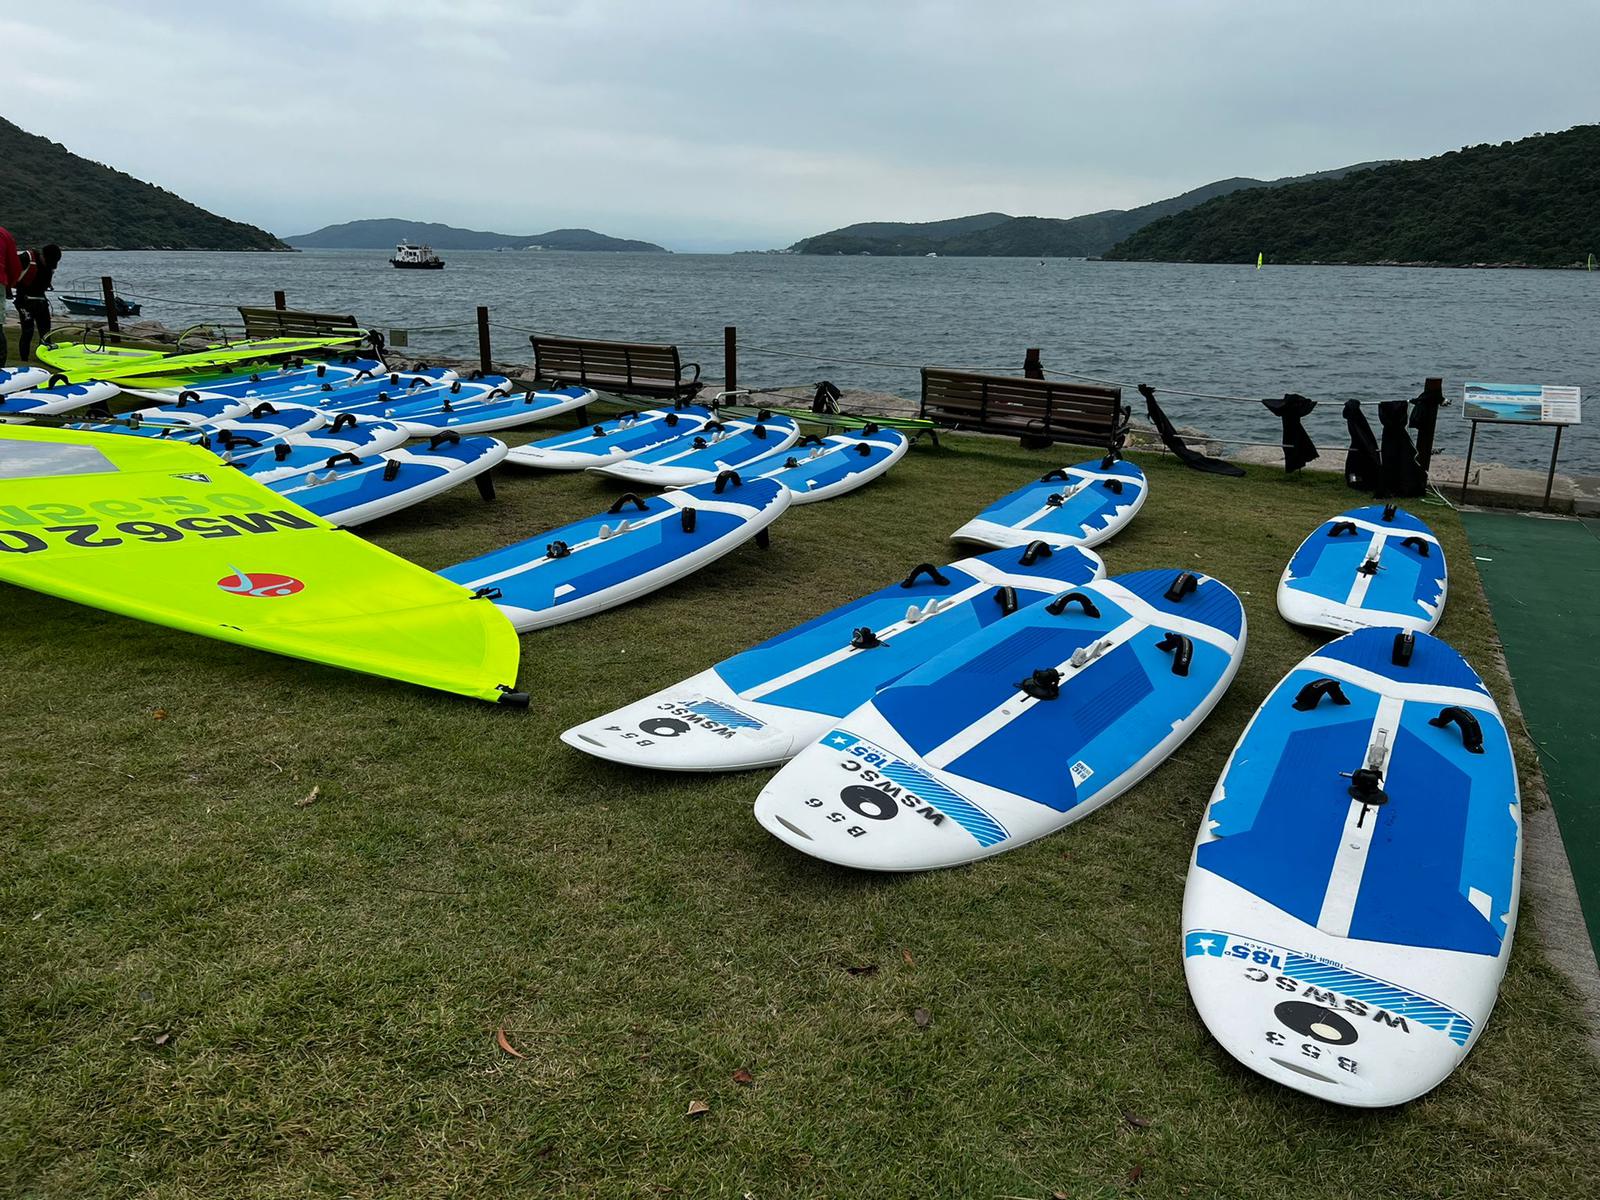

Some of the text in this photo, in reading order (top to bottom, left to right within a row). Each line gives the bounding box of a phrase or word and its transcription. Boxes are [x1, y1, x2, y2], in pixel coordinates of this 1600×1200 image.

[0, 509, 318, 554] M5620
[657, 703, 736, 740] WSWSC
[840, 759, 947, 827] WSWSC
[1243, 941, 1274, 954] BEACH
[1304, 951, 1345, 969] TOUGH-TEC
[1243, 966, 1411, 1035] WSWSC
